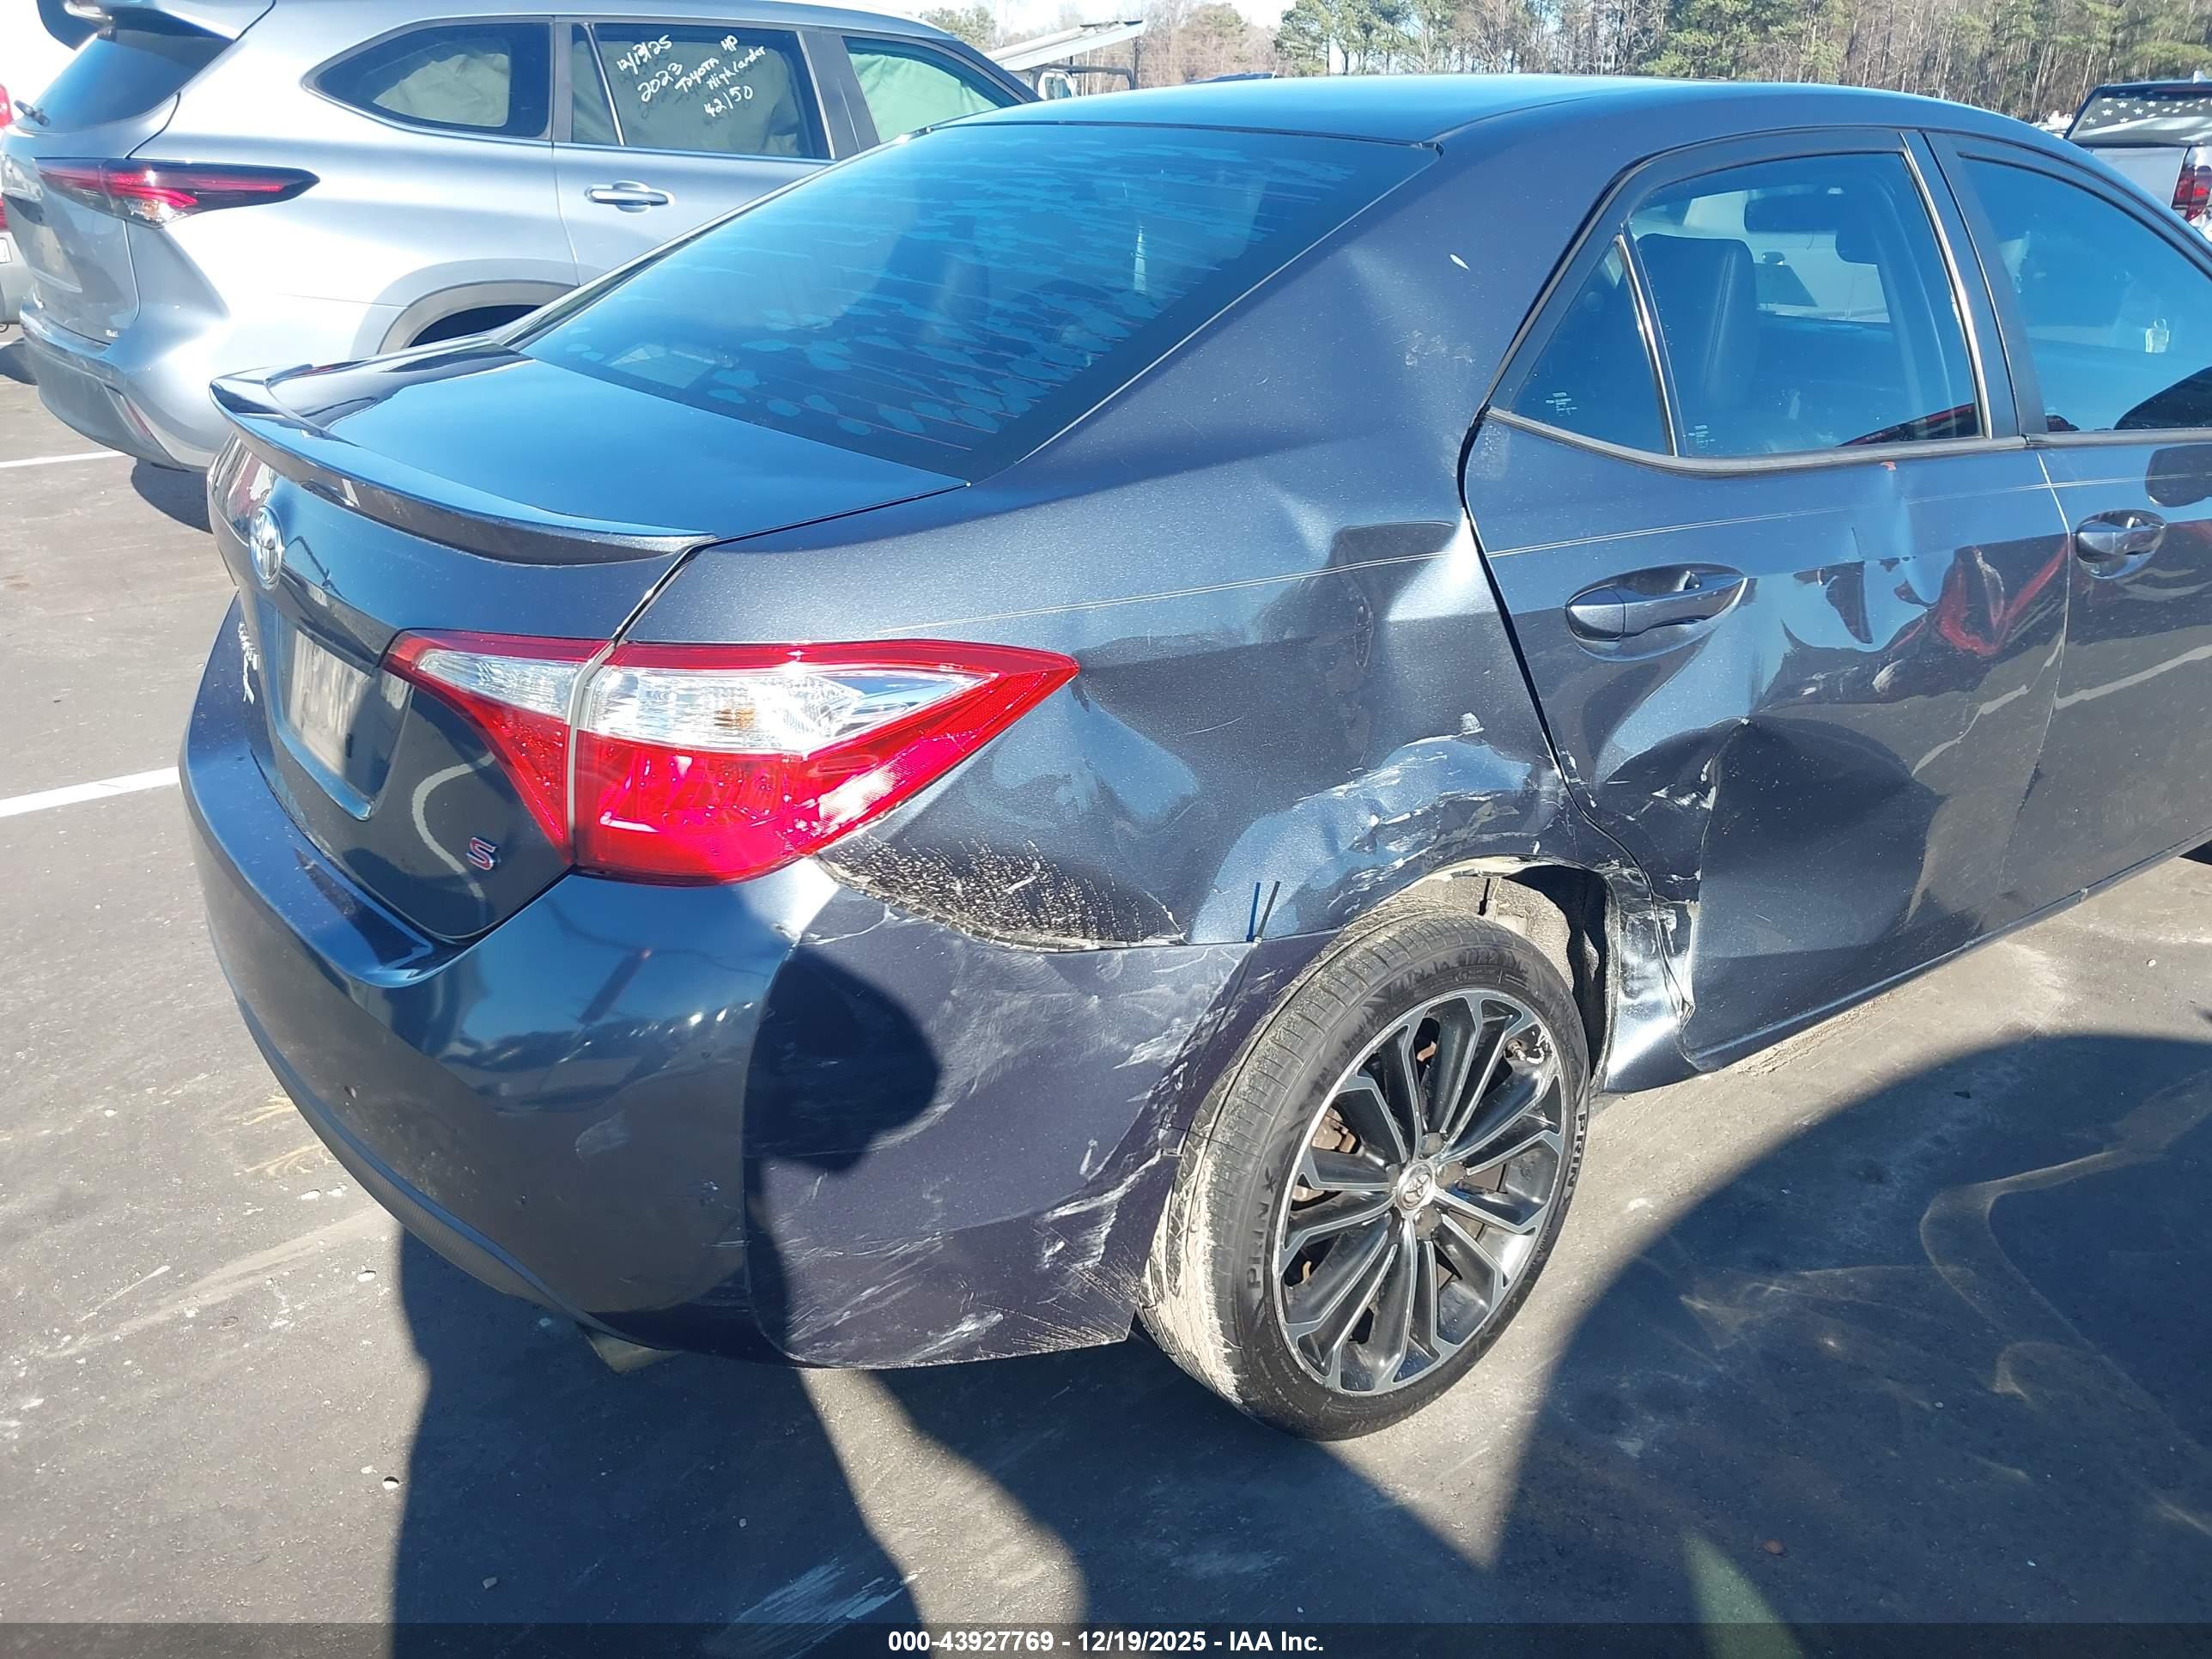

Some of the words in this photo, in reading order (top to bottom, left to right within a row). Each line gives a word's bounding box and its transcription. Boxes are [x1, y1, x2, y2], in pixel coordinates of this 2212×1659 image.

[637, 62, 684, 102] 2023
[703, 85, 753, 118] 42/50
[466, 836, 496, 871] S
